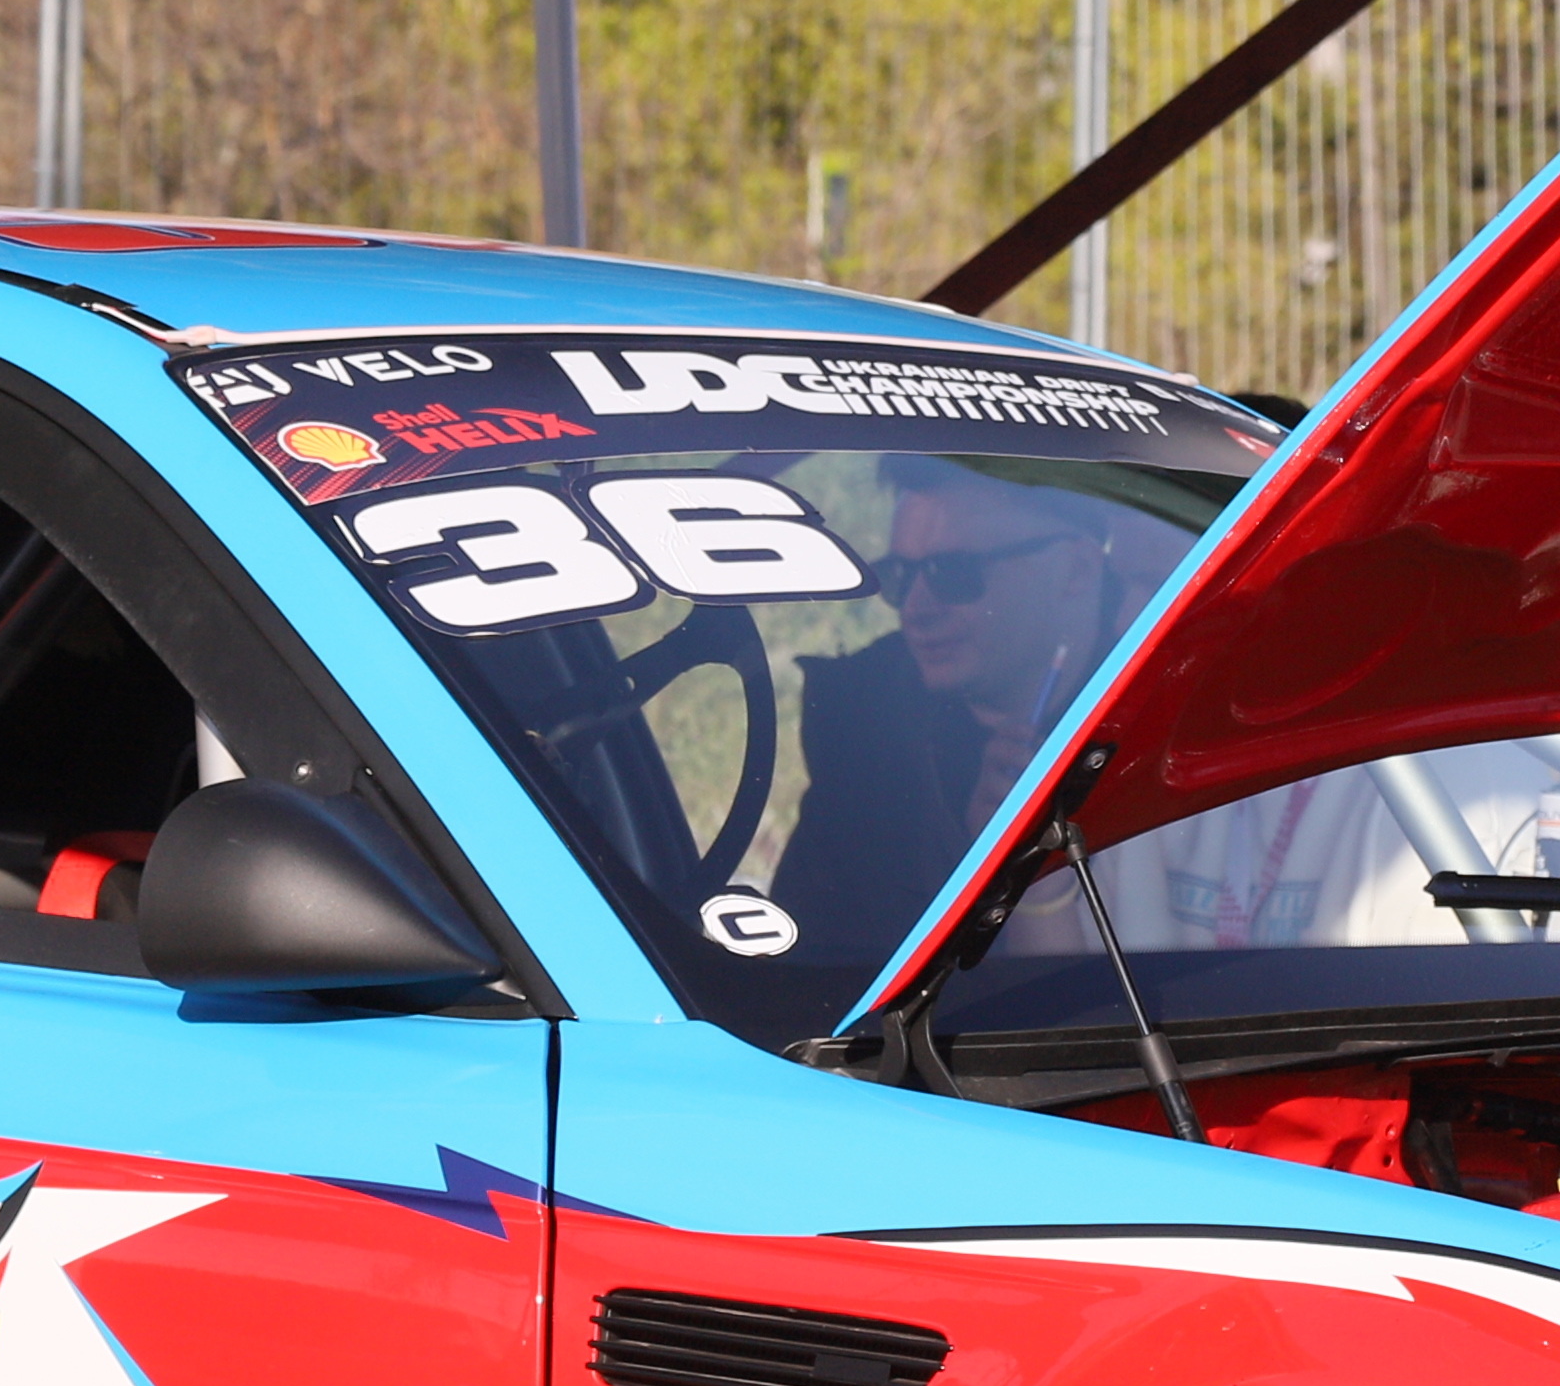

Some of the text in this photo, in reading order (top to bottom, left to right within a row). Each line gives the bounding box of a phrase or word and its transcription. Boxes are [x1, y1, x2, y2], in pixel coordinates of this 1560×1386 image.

[293, 344, 493, 387] VELO
[822, 359, 1132, 398] UKRAINIAN DRIFT
[799, 374, 1159, 415] CHAMPIONSHIP
[372, 403, 461, 431] Shell
[396, 408, 597, 455] HELIX
[351, 476, 864, 628] 36
